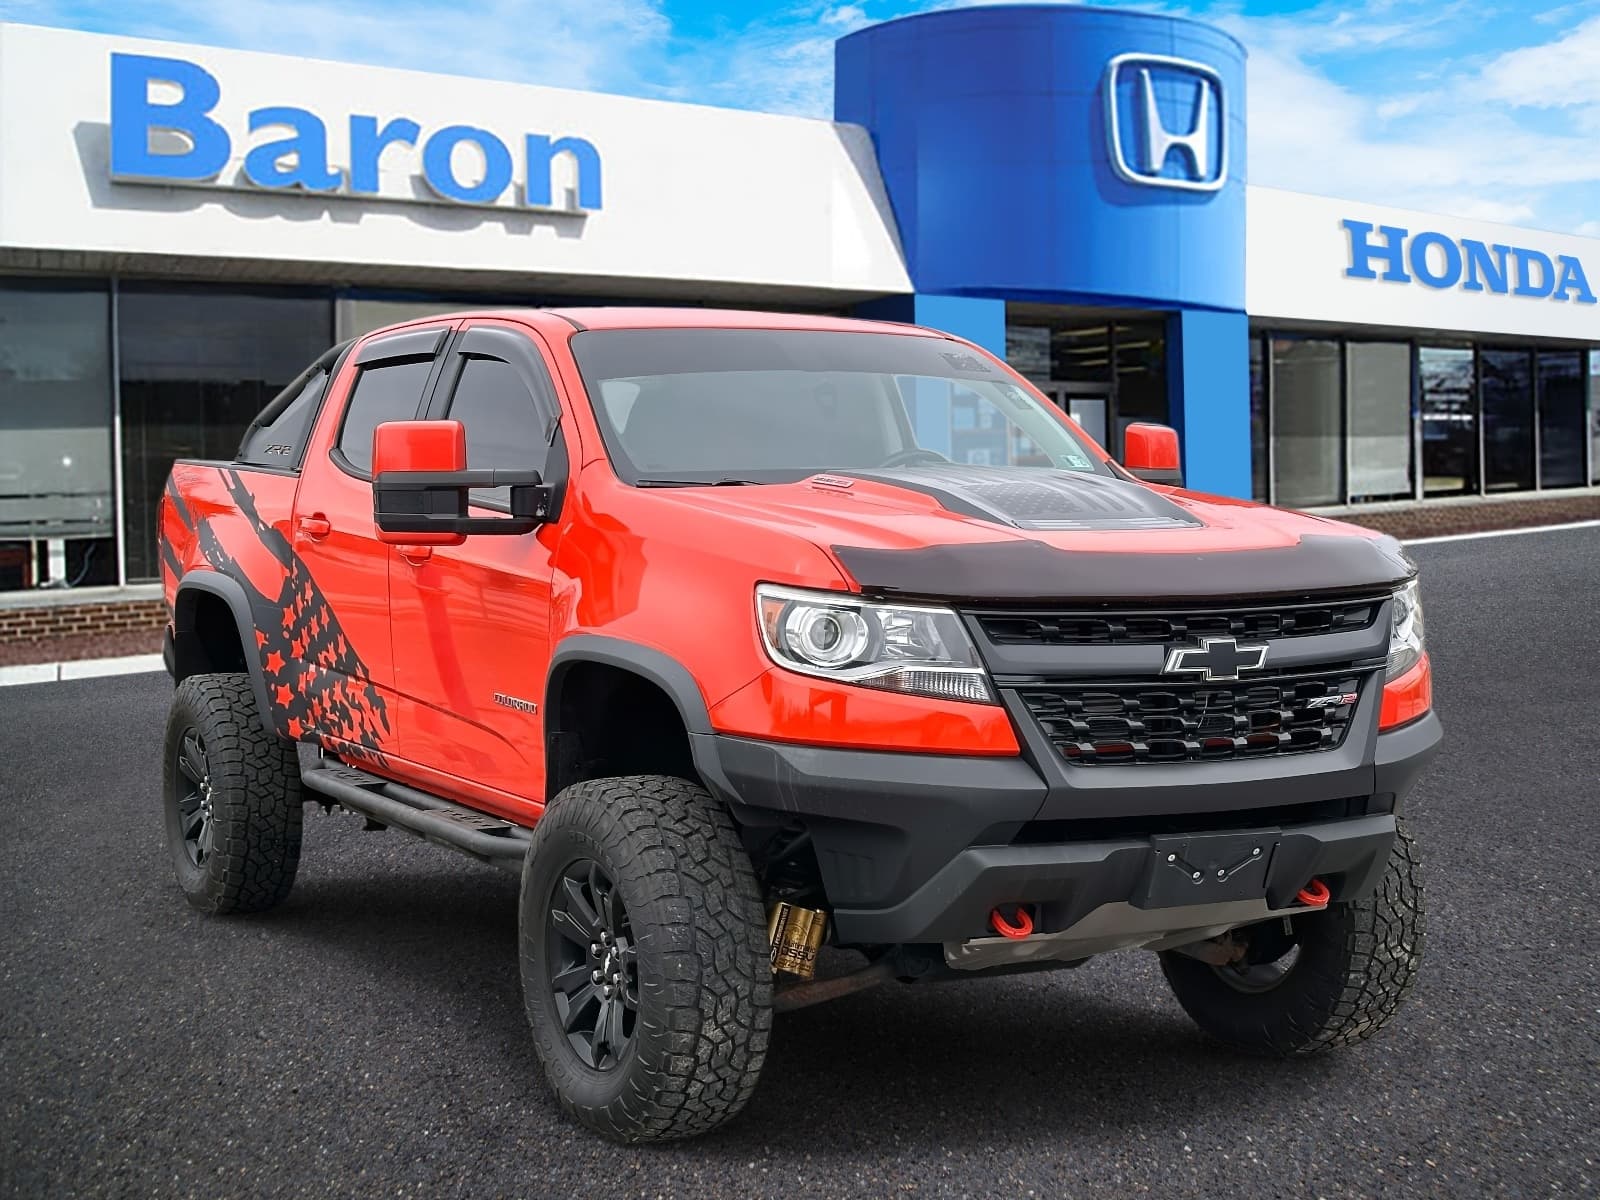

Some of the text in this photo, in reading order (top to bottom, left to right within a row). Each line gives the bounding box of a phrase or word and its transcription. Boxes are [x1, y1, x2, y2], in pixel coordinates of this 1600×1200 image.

[110, 52, 603, 210] Baron
[1342, 218, 1598, 304] HONDA
[1307, 693, 1357, 708] ZR2
